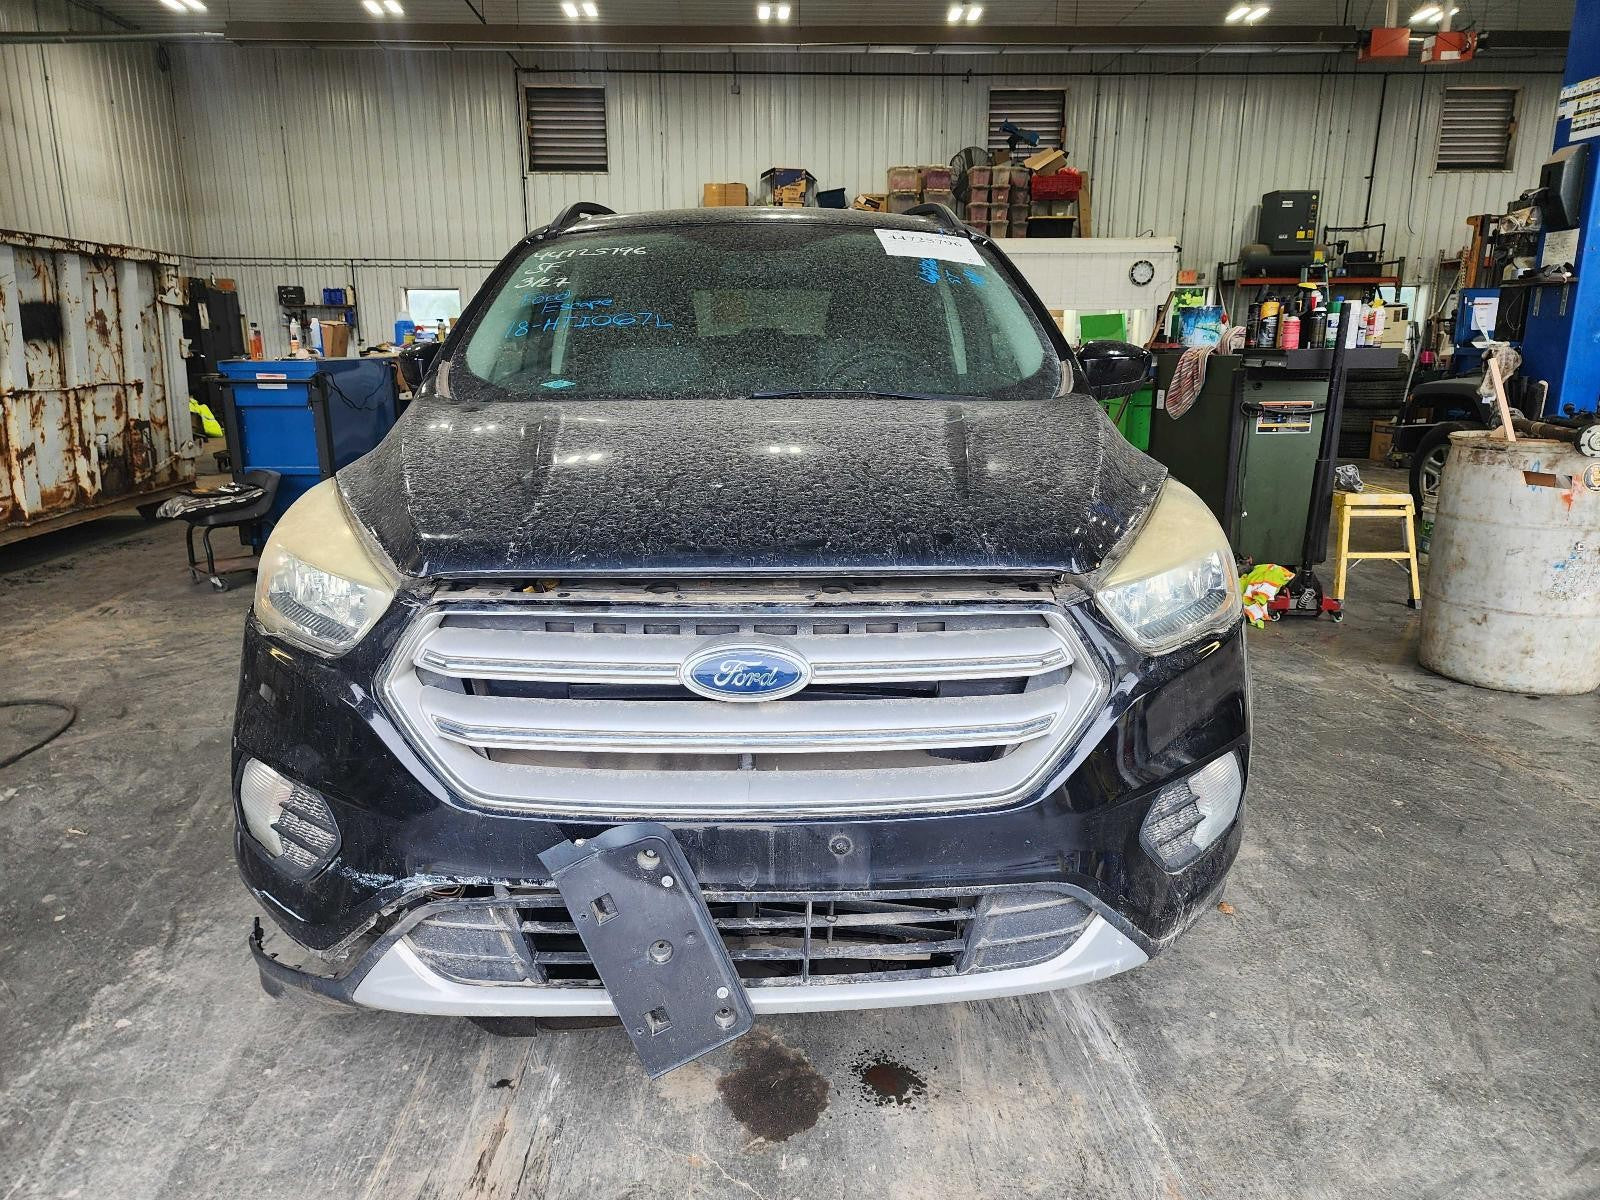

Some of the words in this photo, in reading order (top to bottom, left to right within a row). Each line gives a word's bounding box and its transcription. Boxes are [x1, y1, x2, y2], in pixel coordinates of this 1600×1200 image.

[534, 246, 647, 260] 44725796
[514, 277, 571, 289] 3/27
[541, 298, 614, 314] Escape
[713, 659, 779, 687] Ford
